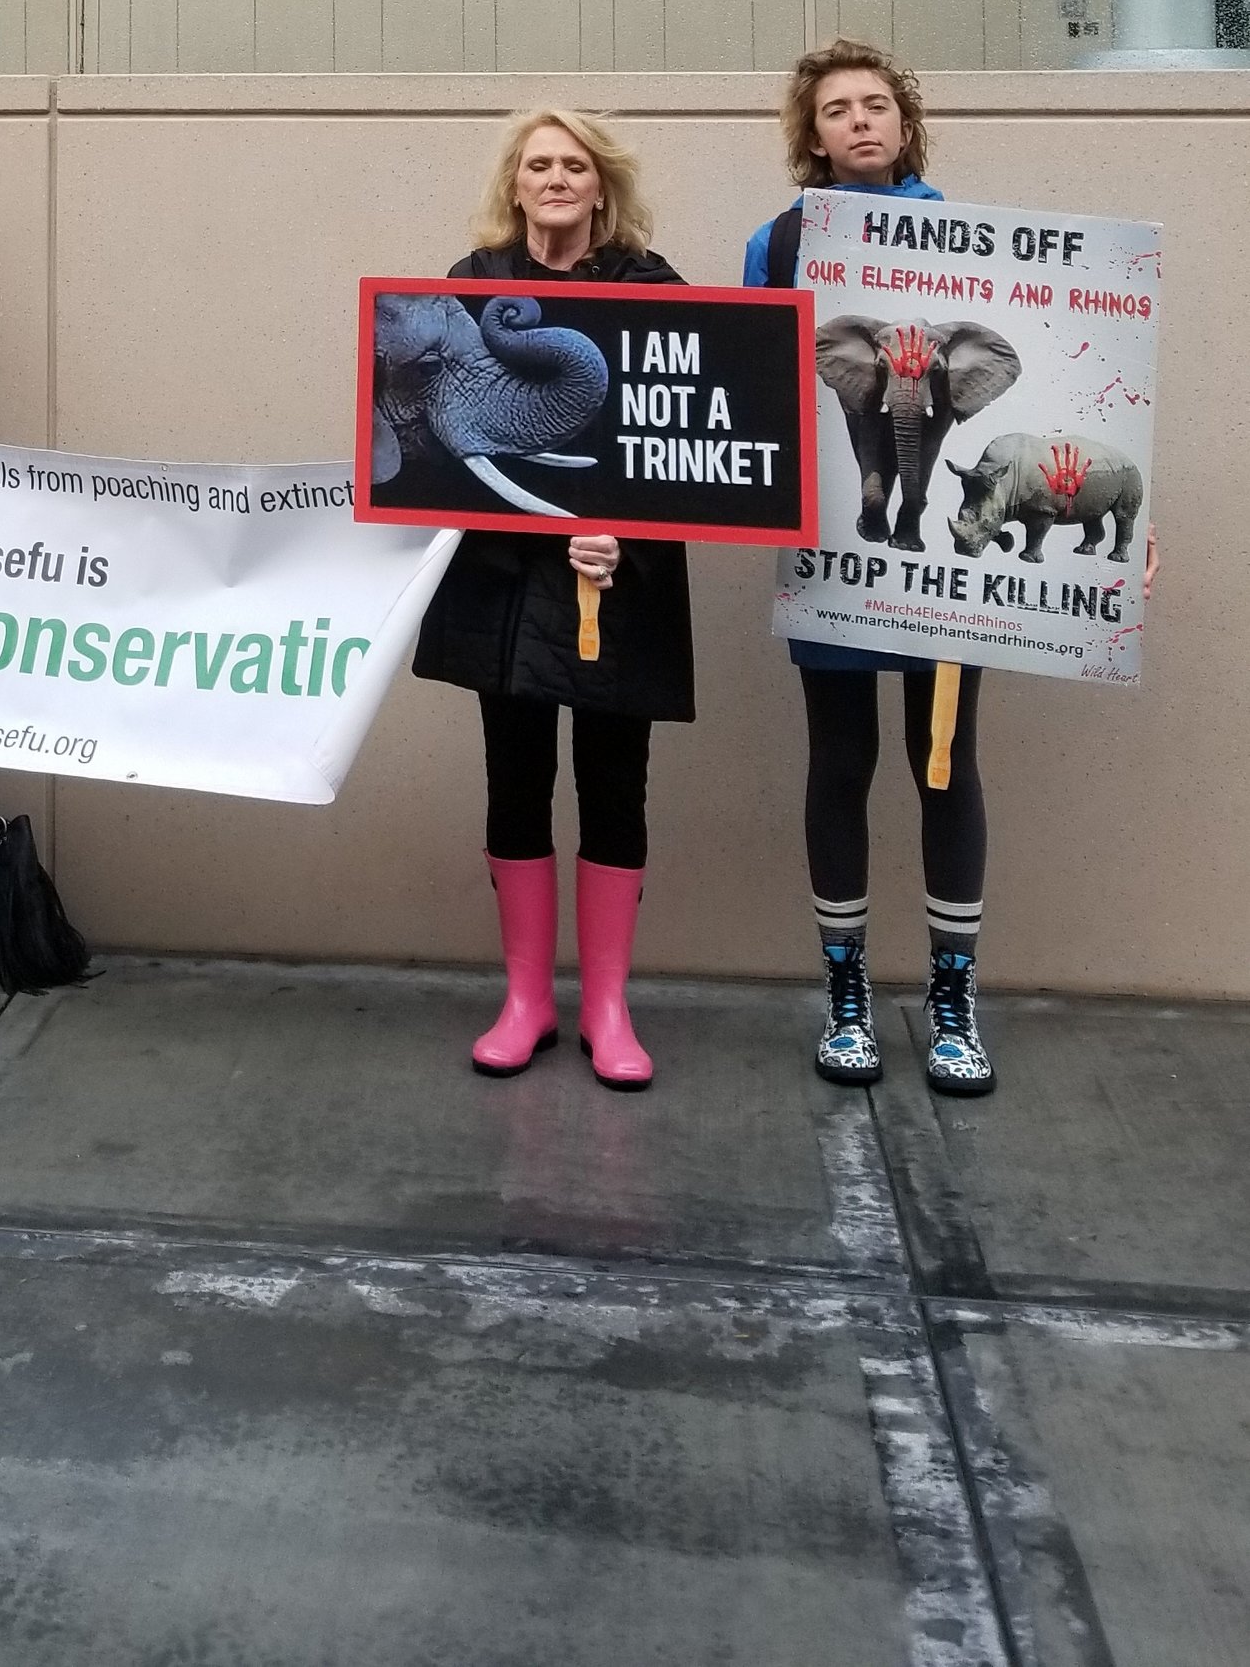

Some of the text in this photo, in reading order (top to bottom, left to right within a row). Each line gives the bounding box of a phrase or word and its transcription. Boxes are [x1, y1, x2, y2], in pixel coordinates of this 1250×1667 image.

[862, 211, 1085, 267] HANDS OFF
[806, 259, 1153, 321] OUR ELEPHANTS AND RHINOS
[621, 330, 701, 376] I AM
[621, 383, 732, 431] NOT A
[617, 435, 780, 487] TRINKET
[27, 464, 84, 494] from
[92, 475, 200, 512] poaching
[208, 485, 251, 514] and
[76, 545, 110, 588] is
[794, 548, 1122, 624] STOP THE KILLING
[816, 607, 1084, 659] www.march4elephantsandrhinos.org
[864, 598, 1023, 632] #March4ElesAndRhinos
